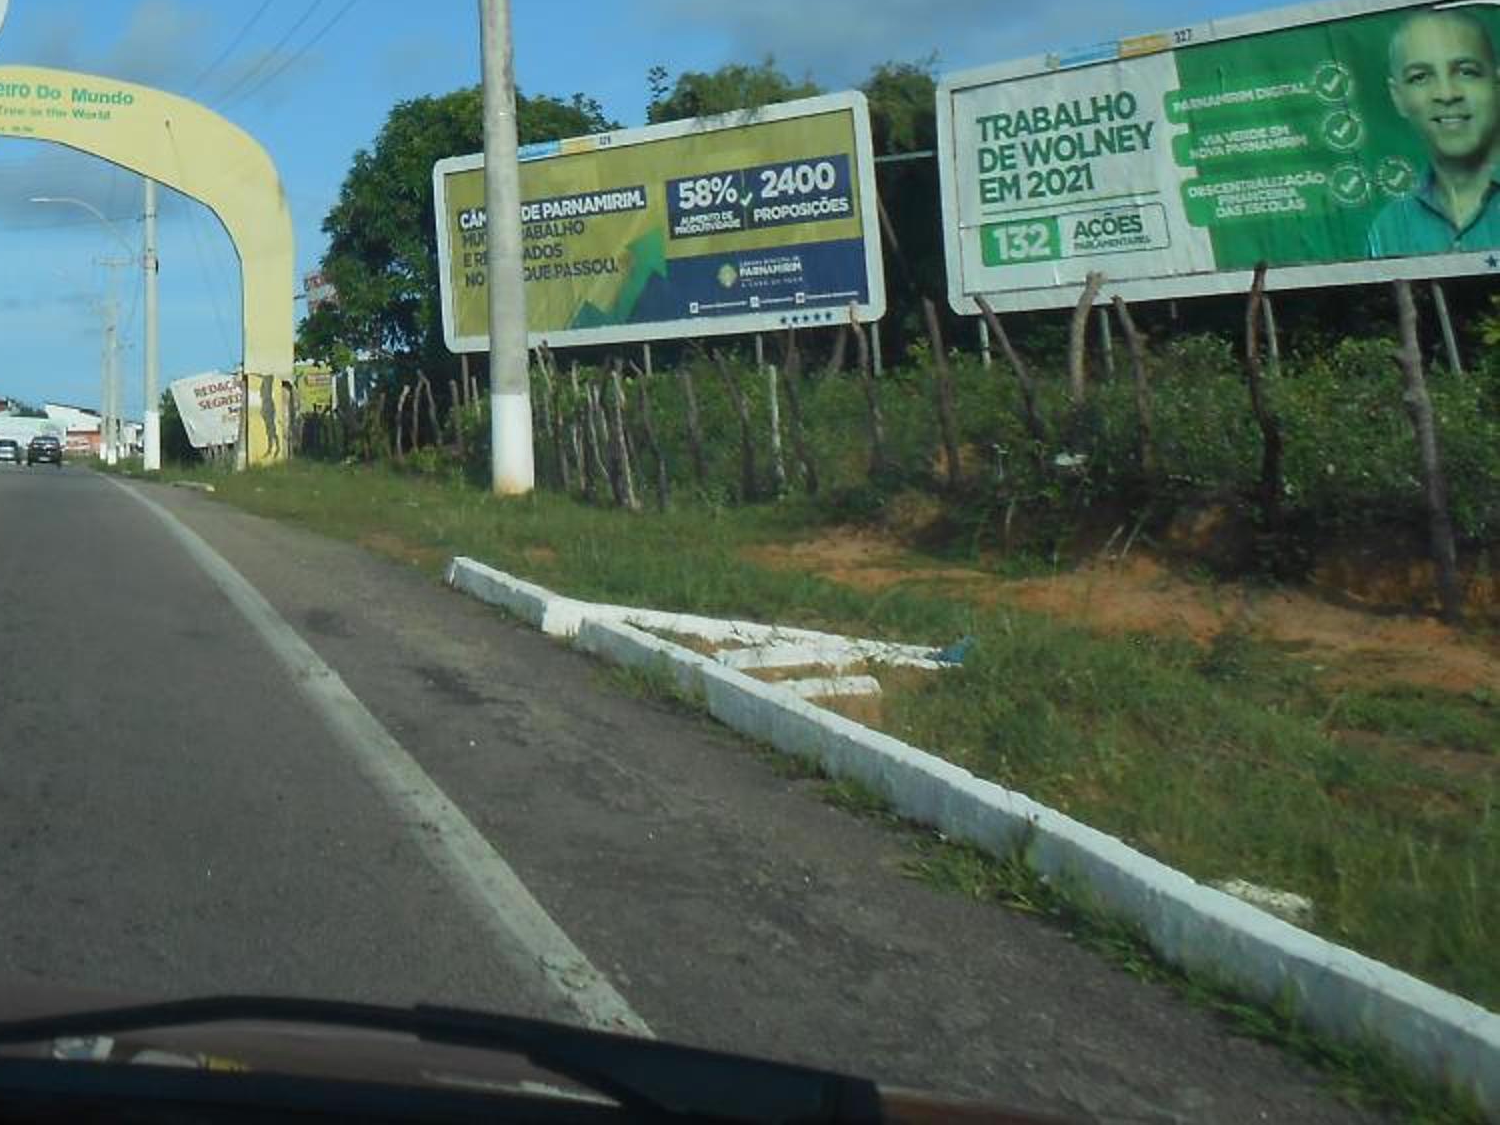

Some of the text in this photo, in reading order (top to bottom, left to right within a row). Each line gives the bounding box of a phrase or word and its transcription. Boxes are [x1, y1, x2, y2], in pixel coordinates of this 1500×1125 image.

[36, 85, 62, 99] Do
[71, 88, 134, 105] Mundo
[72, 108, 112, 120] World
[976, 91, 1137, 142] TRABALHO
[978, 121, 1155, 173] DE WOLNEY
[678, 174, 738, 210] 58%
[760, 162, 836, 198] 2400
[979, 163, 1095, 204] EM 2021
[521, 203, 541, 222] DE
[753, 196, 849, 222] PROPOSIÇÕES
[1073, 212, 1144, 240] AÇÕES
[992, 222, 1051, 260] 132
